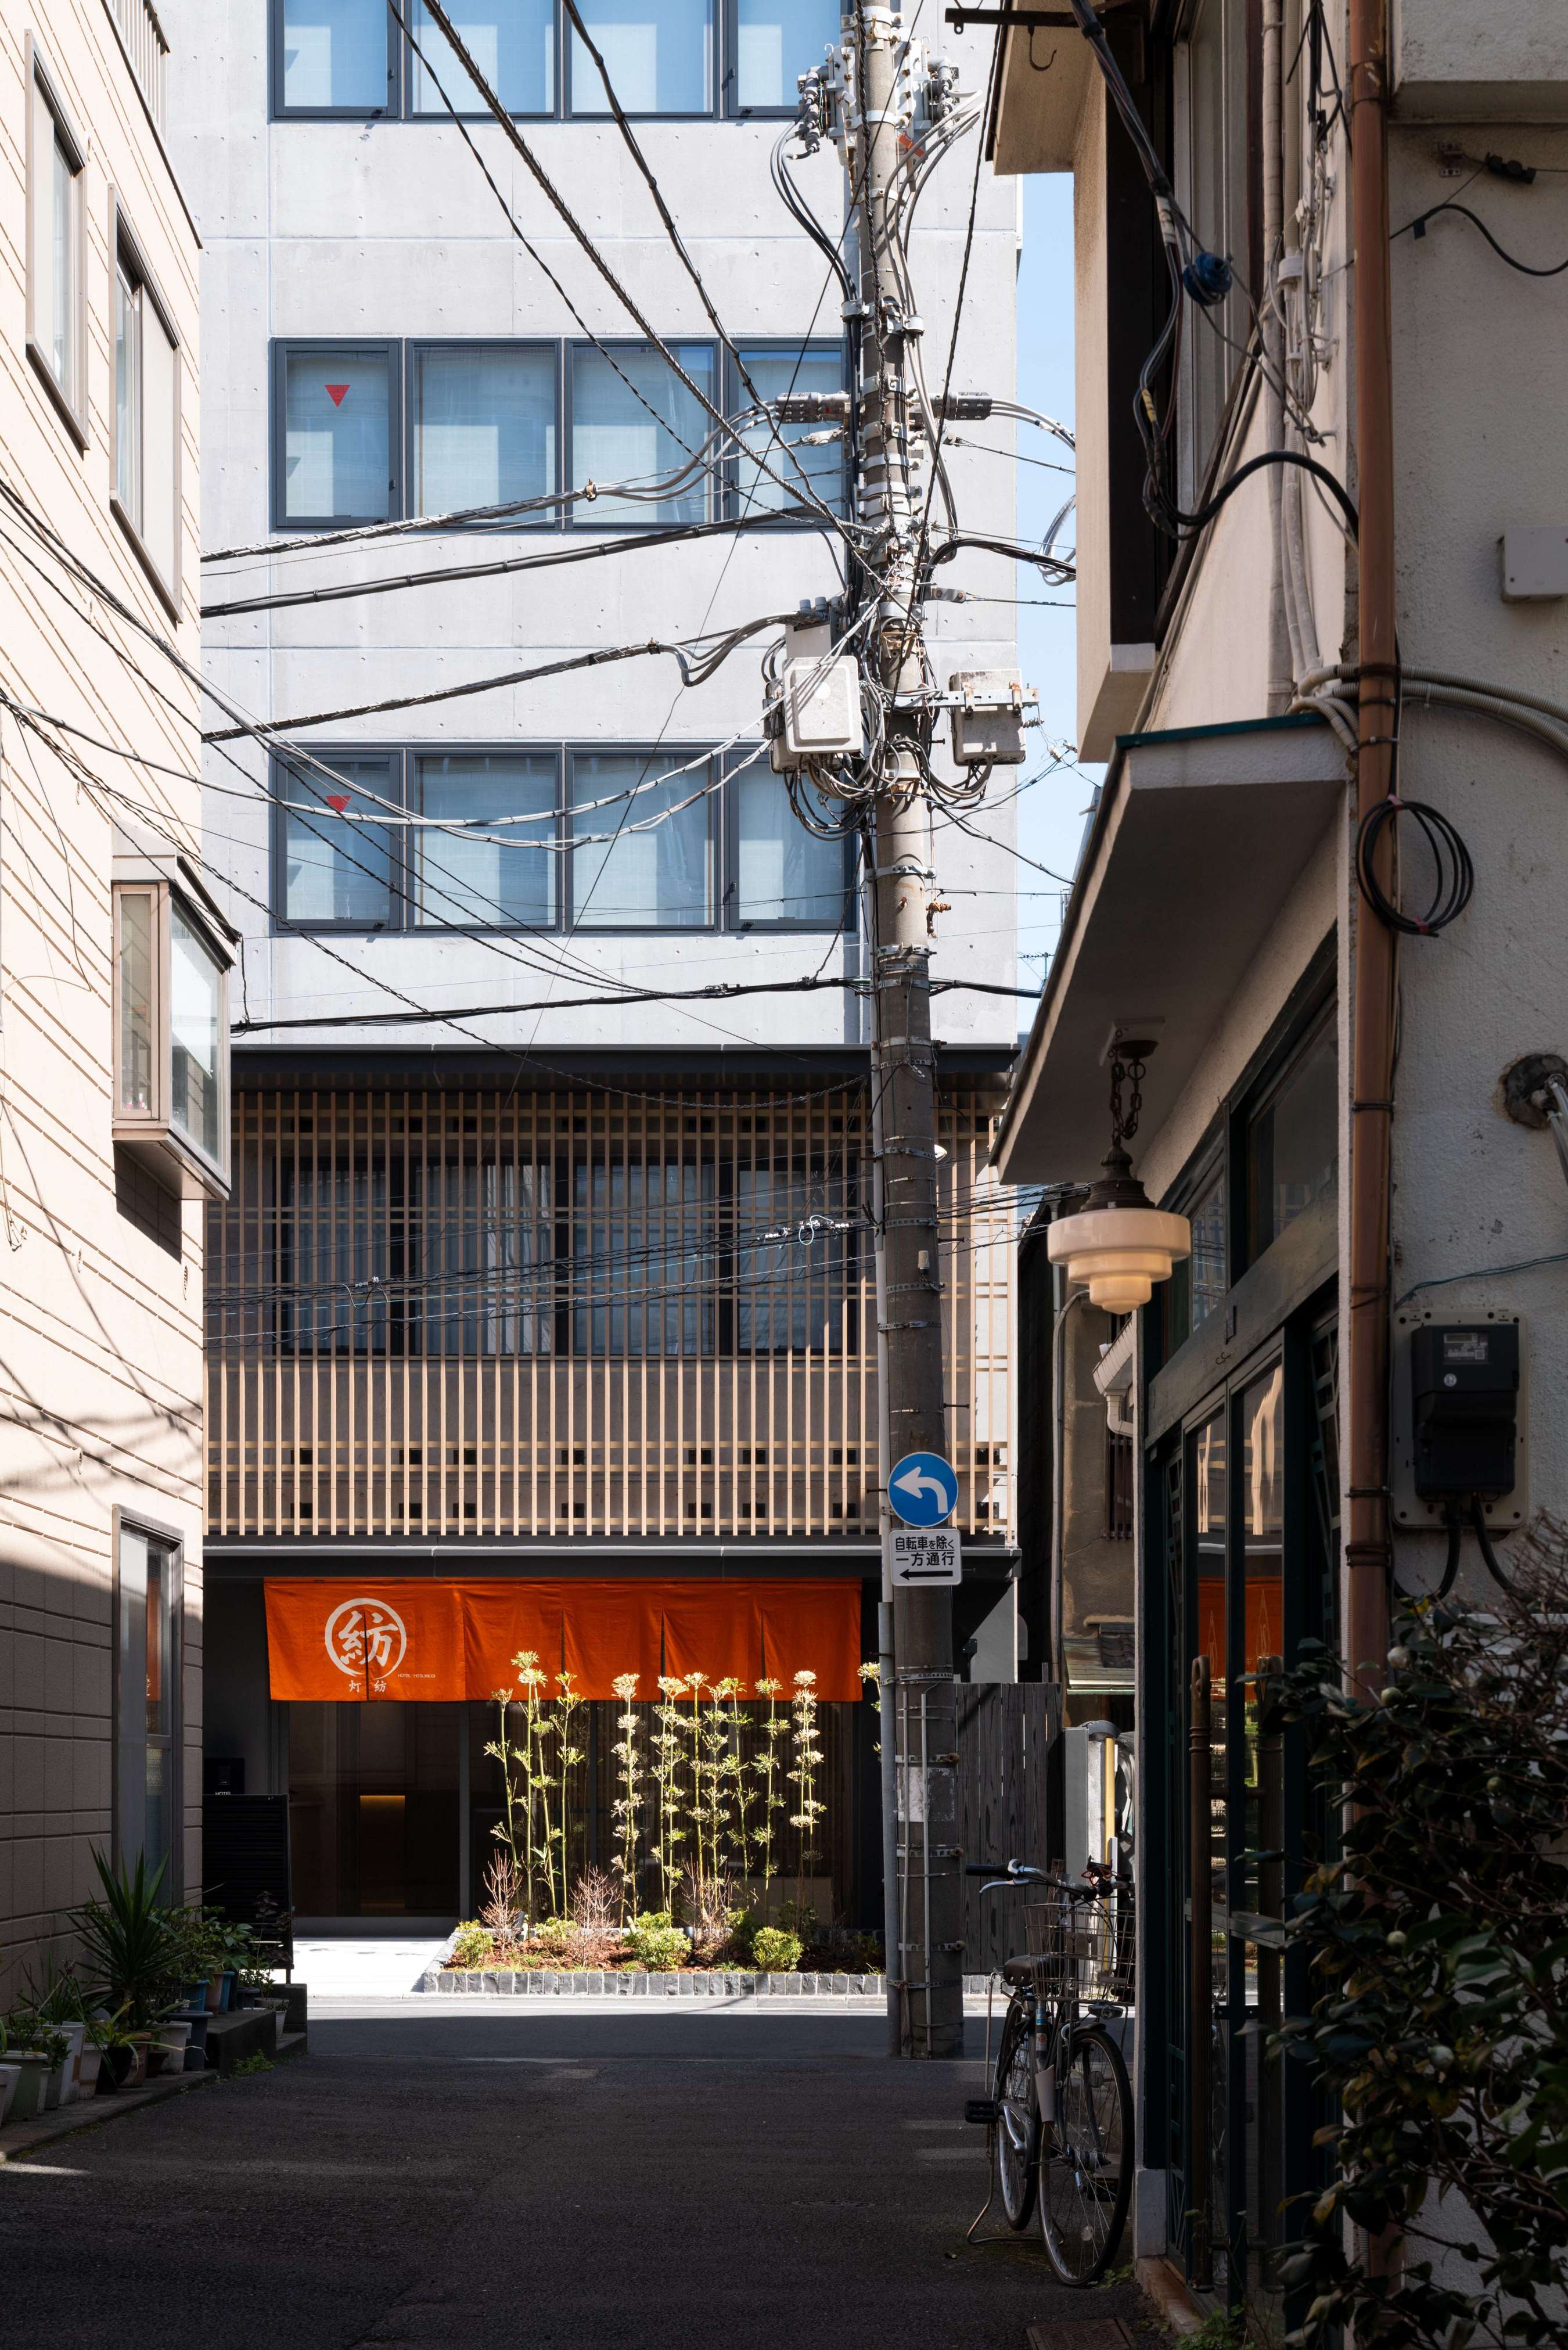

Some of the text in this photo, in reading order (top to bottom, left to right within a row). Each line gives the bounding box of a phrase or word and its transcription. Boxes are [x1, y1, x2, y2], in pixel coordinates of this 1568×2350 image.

[896, 1535, 954, 1550] 自転車を除く
[896, 1551, 955, 1566] 一方通行
[338, 1610, 398, 1667] 紡
